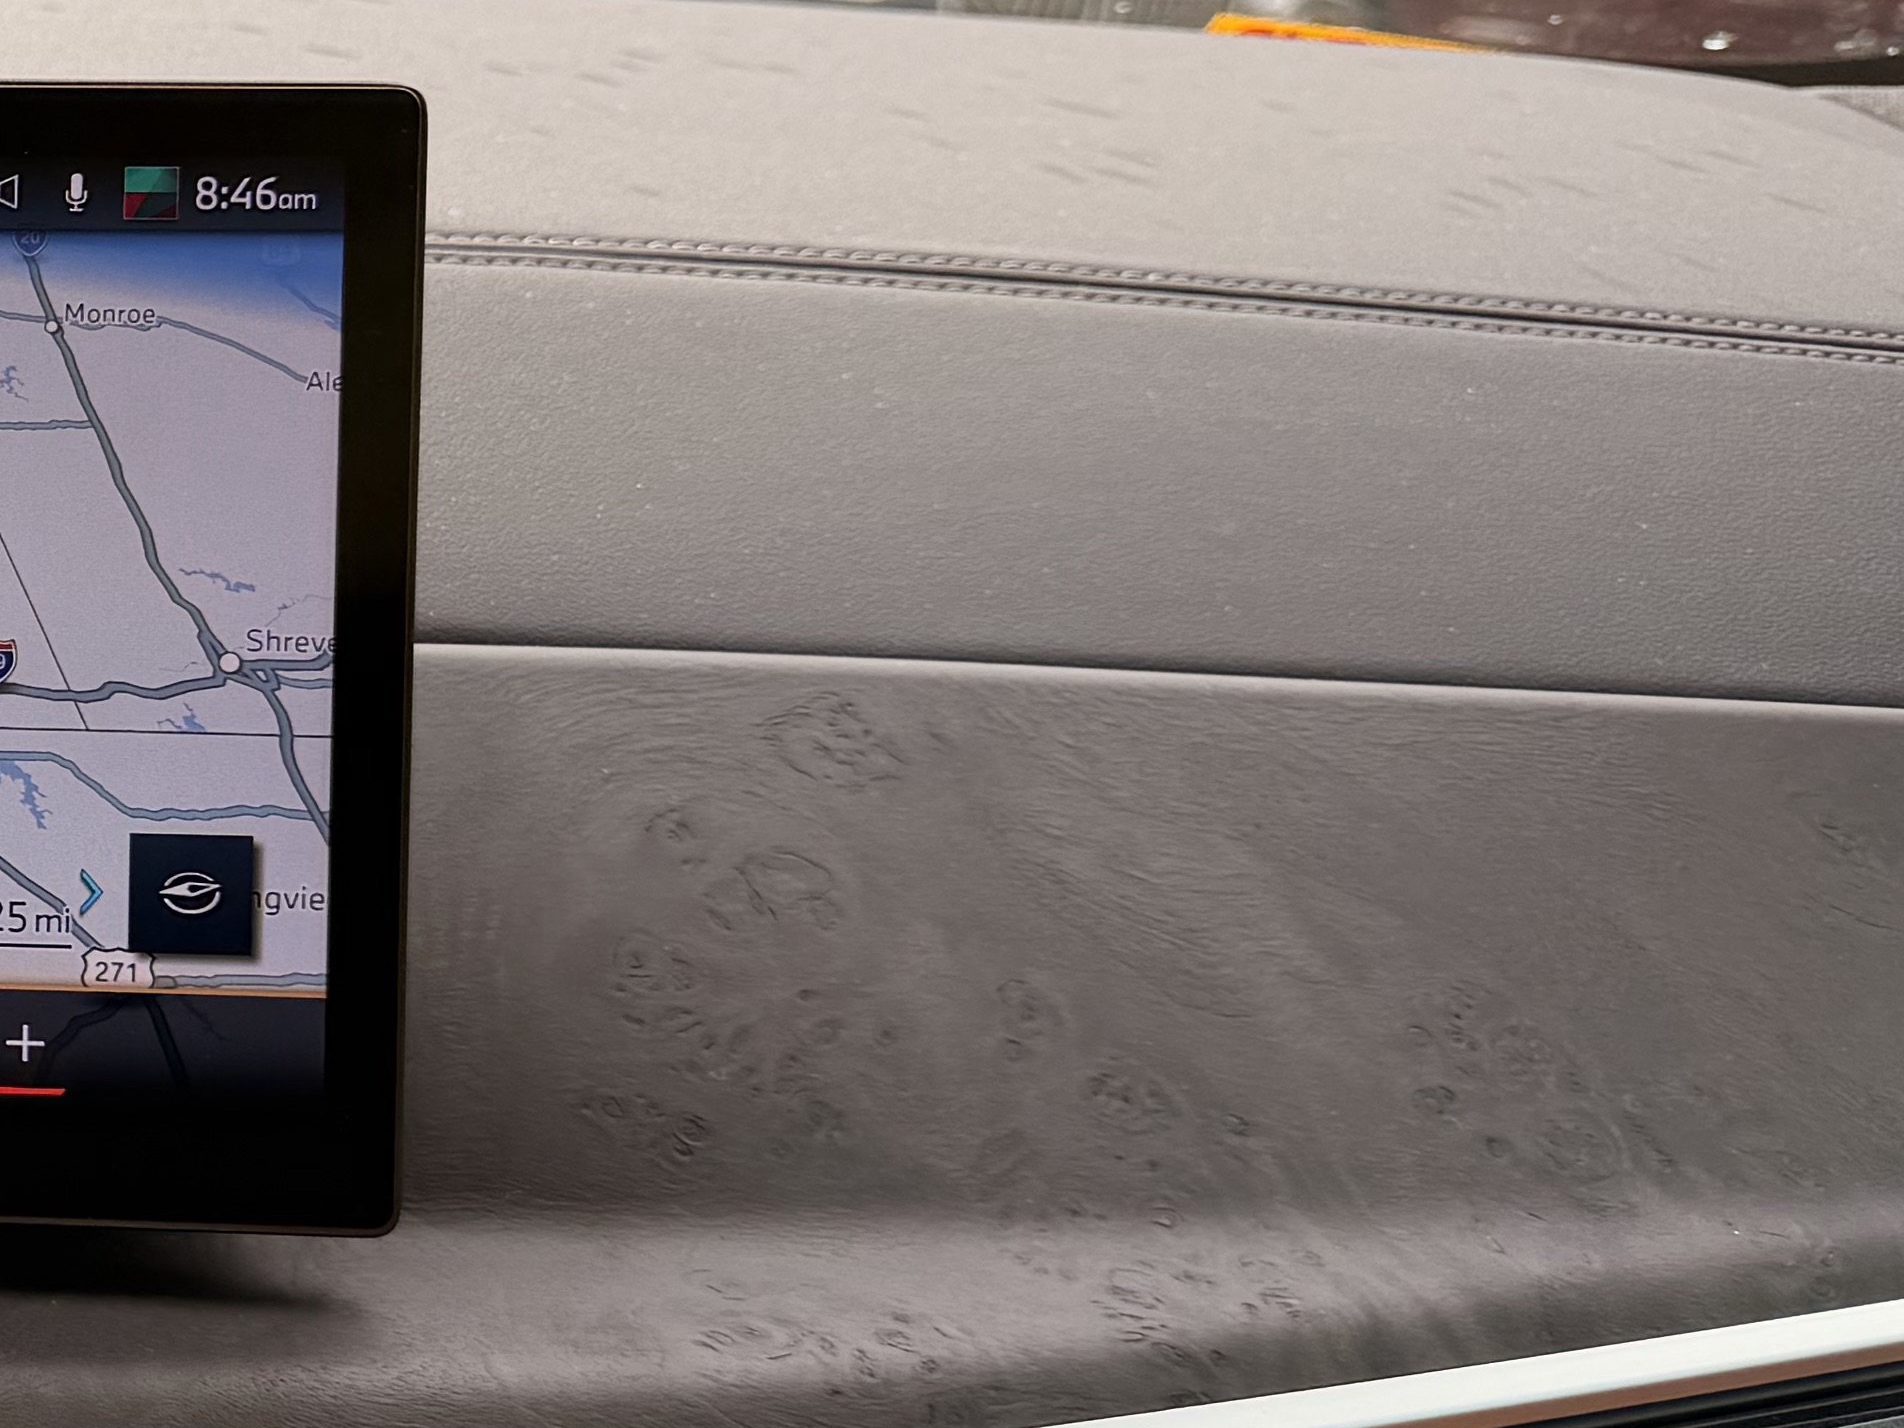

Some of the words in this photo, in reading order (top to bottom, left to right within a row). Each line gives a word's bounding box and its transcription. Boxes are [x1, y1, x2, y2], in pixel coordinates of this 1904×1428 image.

[196, 177, 317, 211] 8:46am
[65, 304, 155, 324] Monroe
[36, 908, 71, 933] mi
[95, 962, 136, 983] 271
